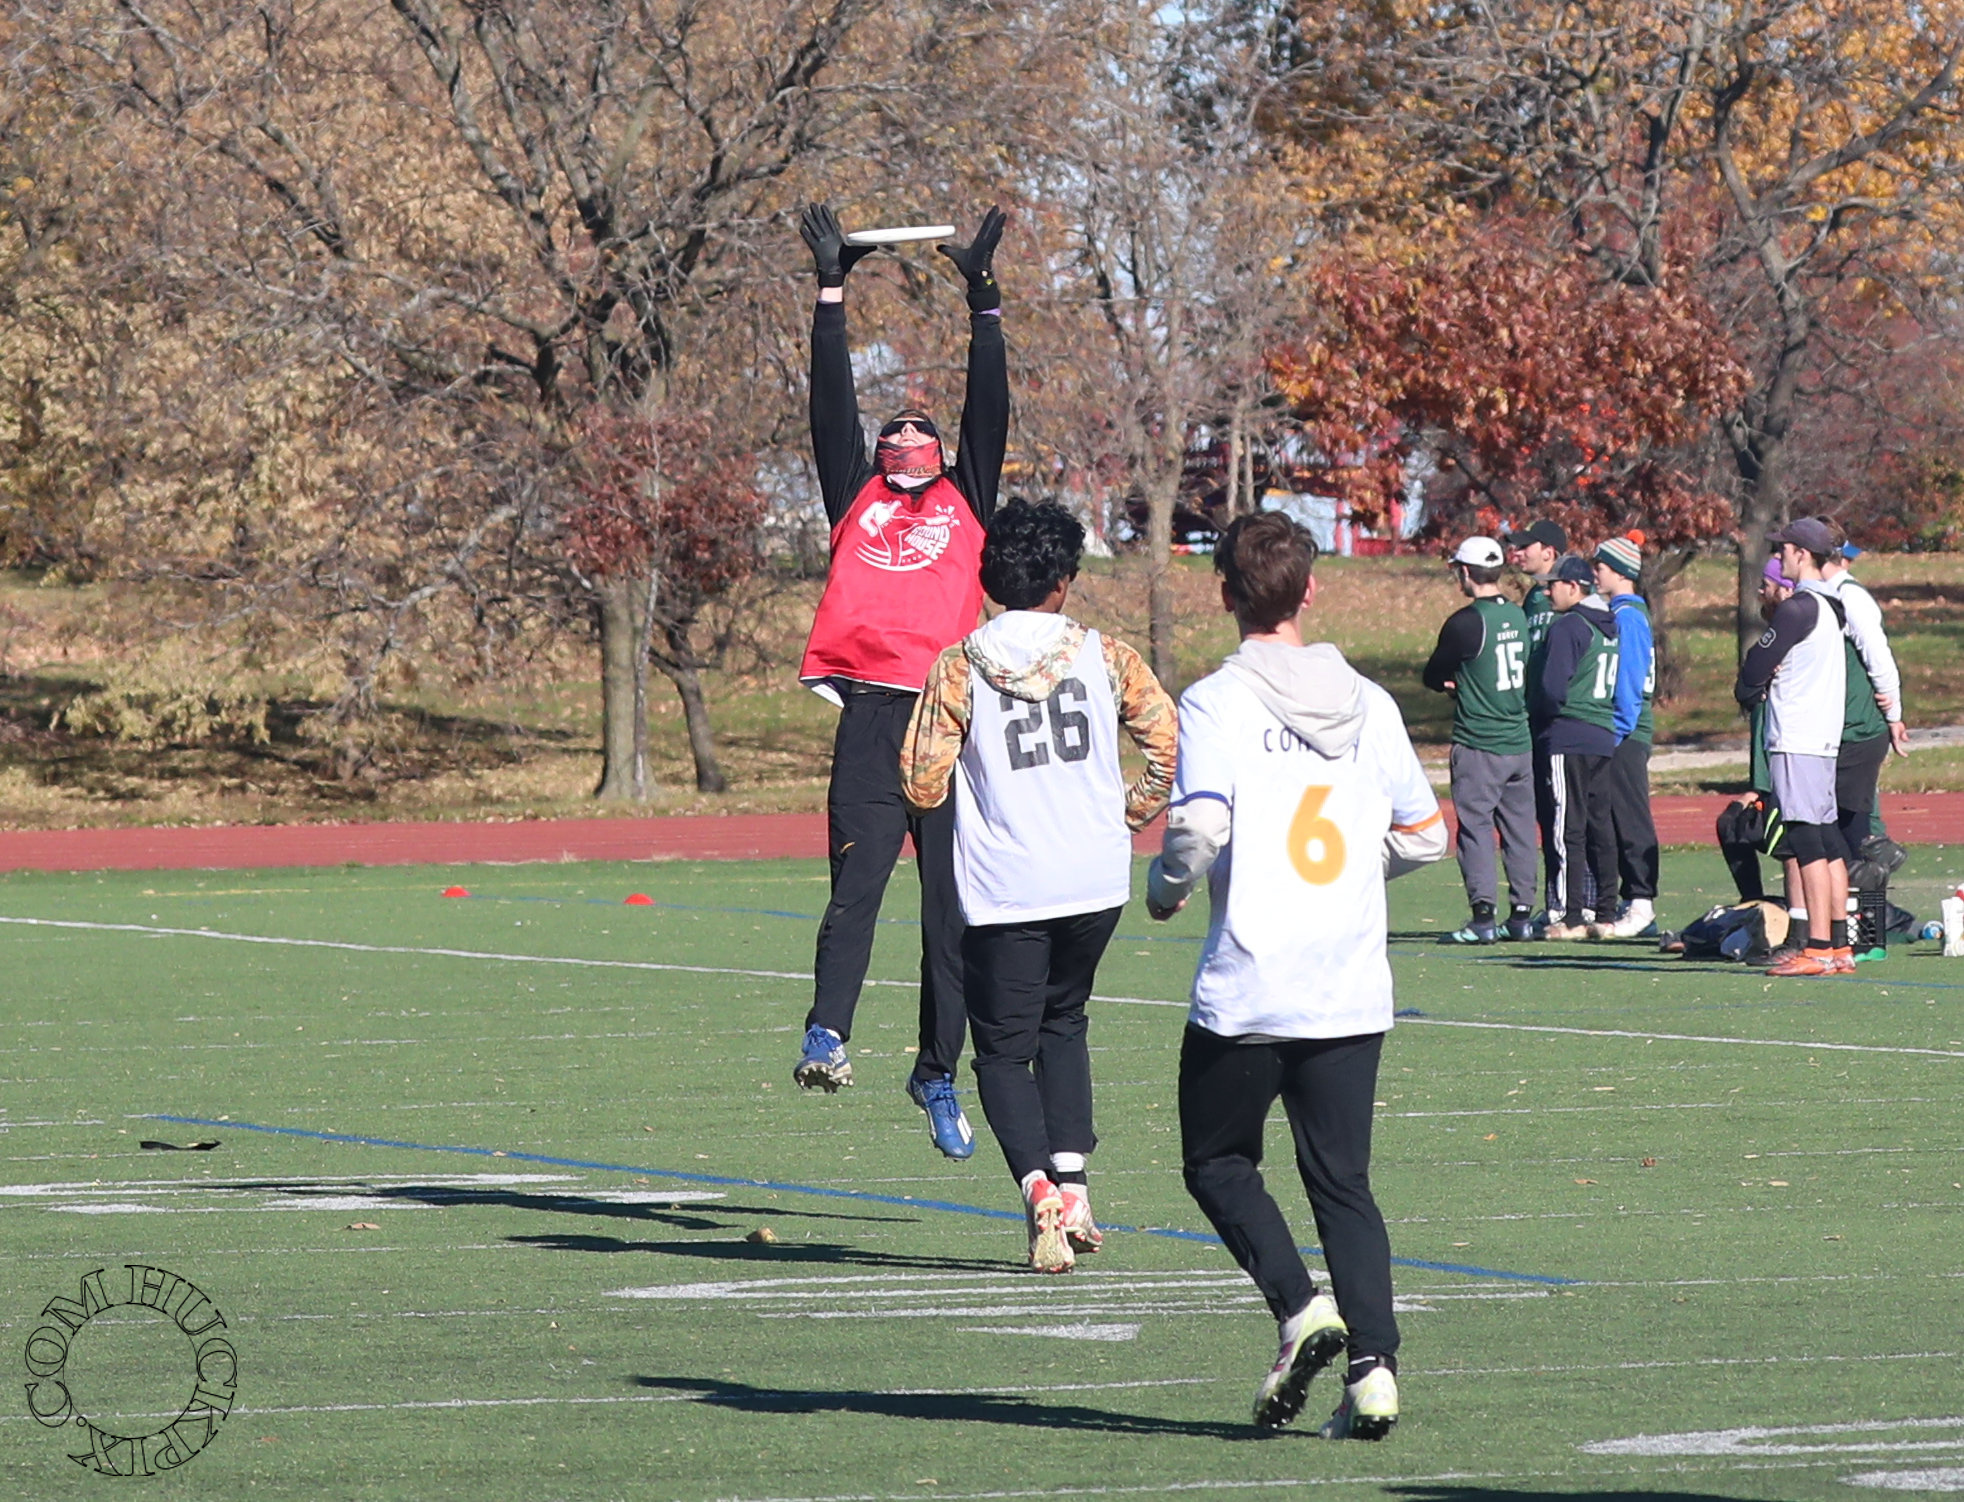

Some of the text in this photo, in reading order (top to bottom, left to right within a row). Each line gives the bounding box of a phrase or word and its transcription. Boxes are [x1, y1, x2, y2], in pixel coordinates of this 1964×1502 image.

[904, 533, 947, 560] HOUSE
[911, 524, 950, 544] ROUND
[1495, 641, 1524, 691] 15
[1593, 653, 1619, 699] 14
[999, 677, 1090, 771] 26
[1286, 784, 1347, 886] 6
